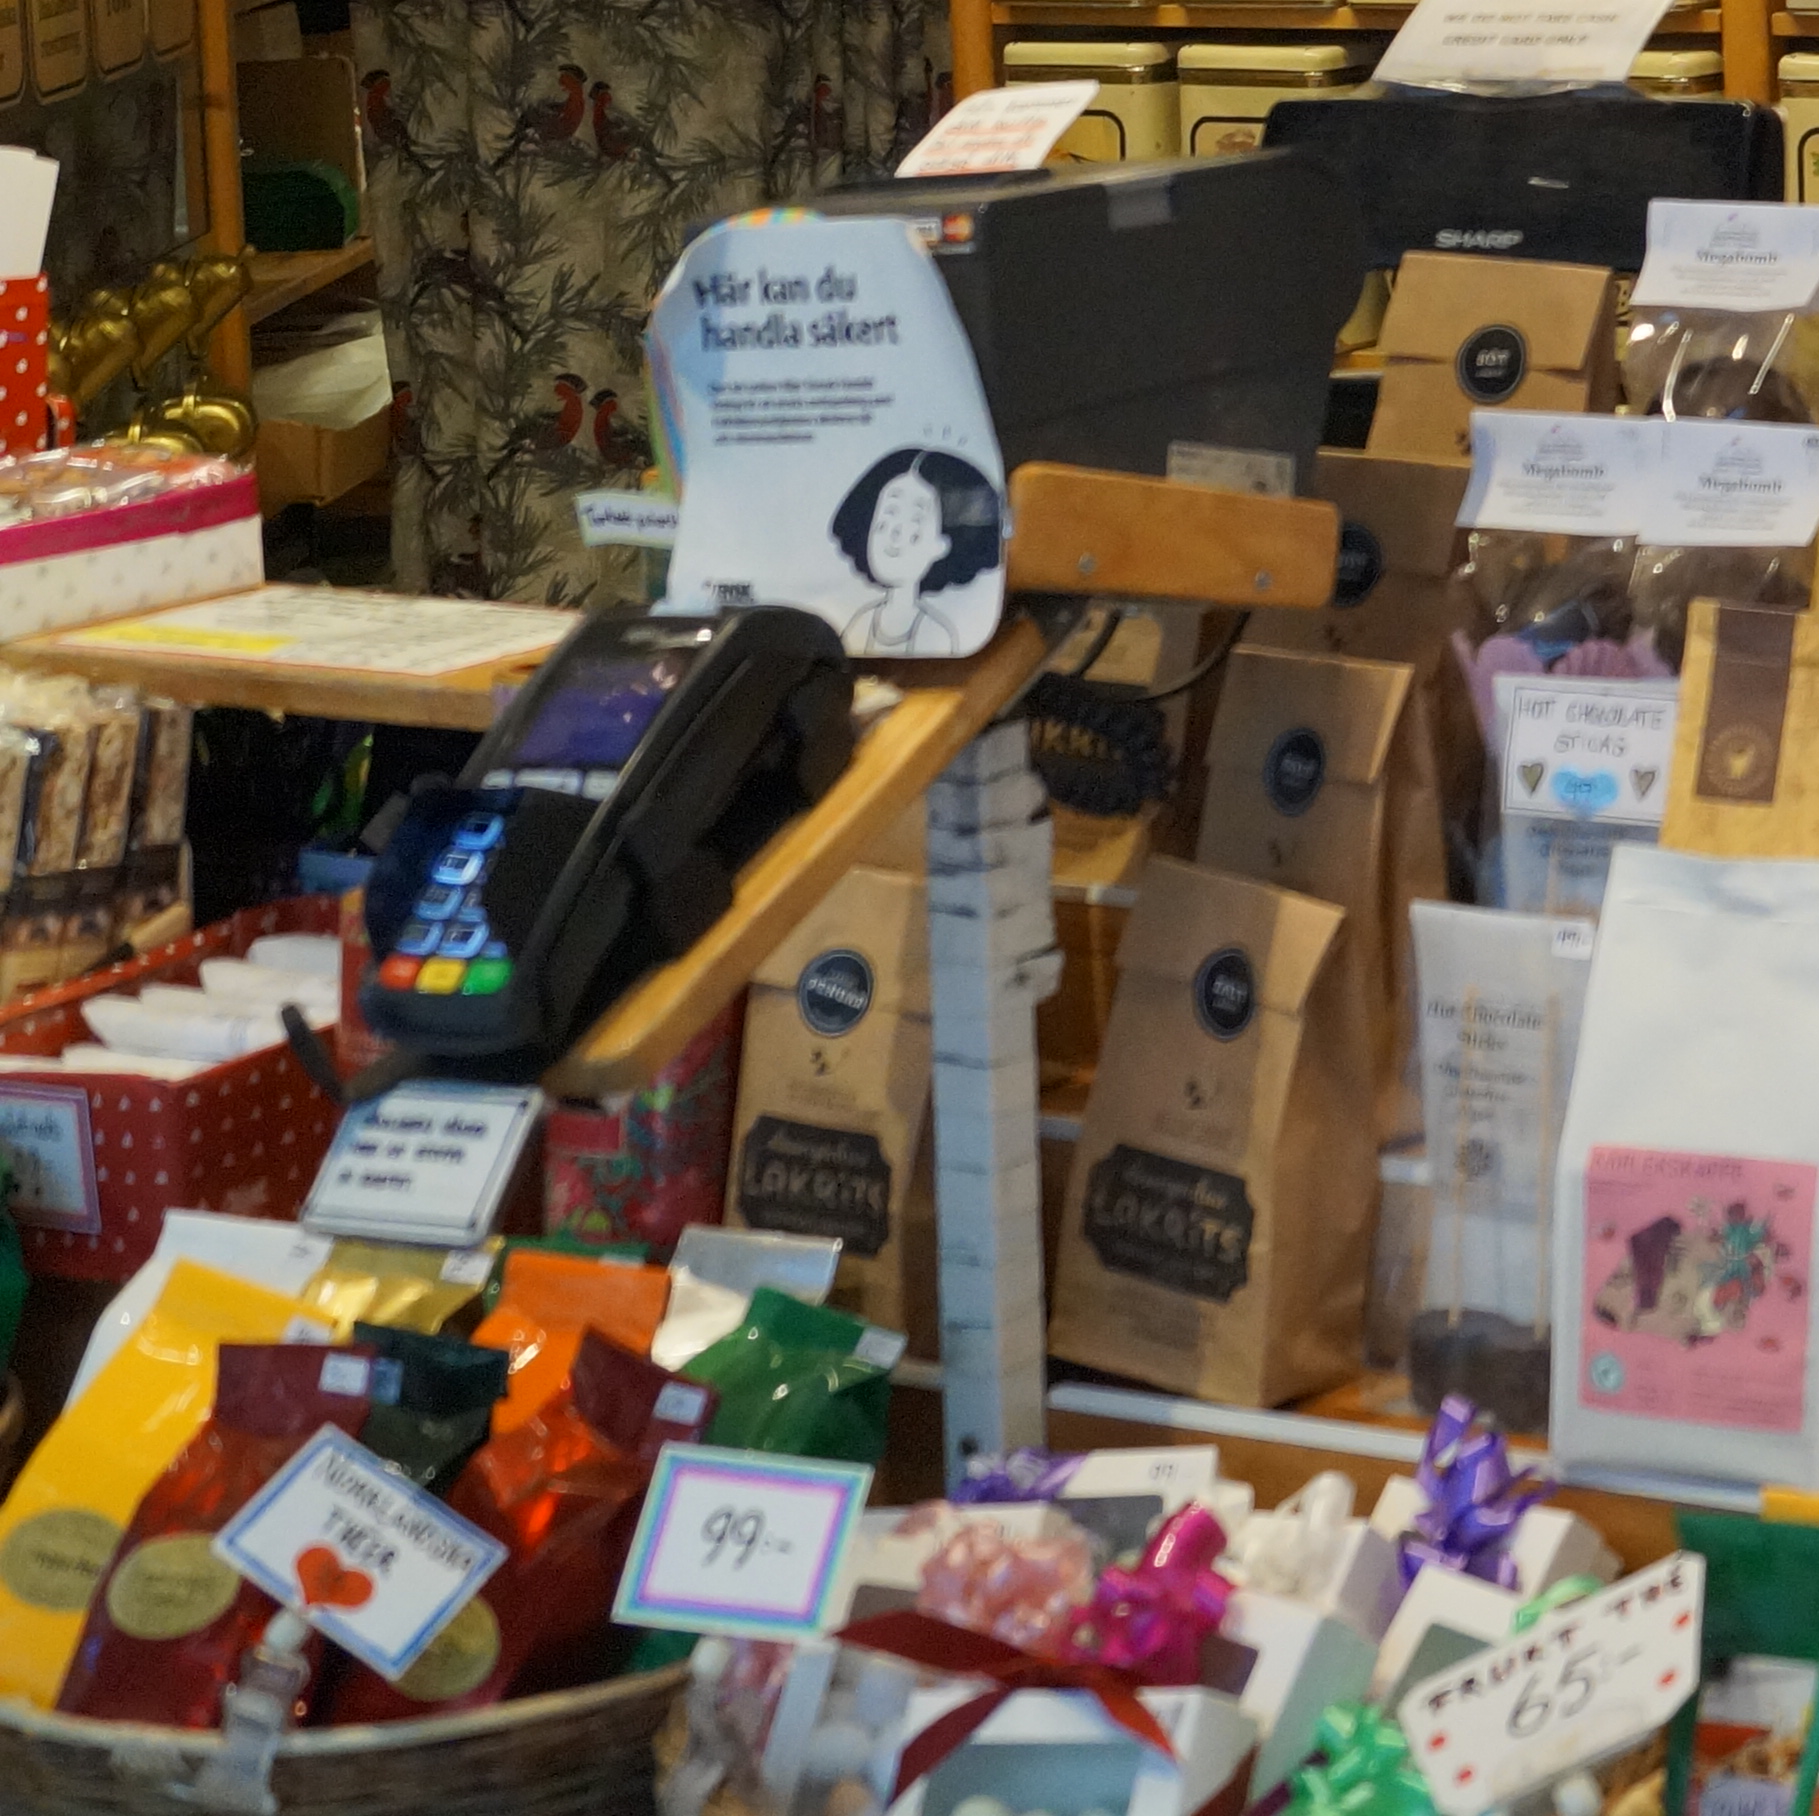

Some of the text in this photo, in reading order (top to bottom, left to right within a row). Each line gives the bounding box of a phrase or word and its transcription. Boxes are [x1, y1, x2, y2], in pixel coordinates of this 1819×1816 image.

[1435, 230, 1523, 249] SHARP
[694, 266, 857, 308] Här kan du
[701, 312, 900, 351] handla säkert
[1517, 697, 1664, 731] HOT CHOCOLATE
[1427, 1622, 1587, 1717] FRUKT
